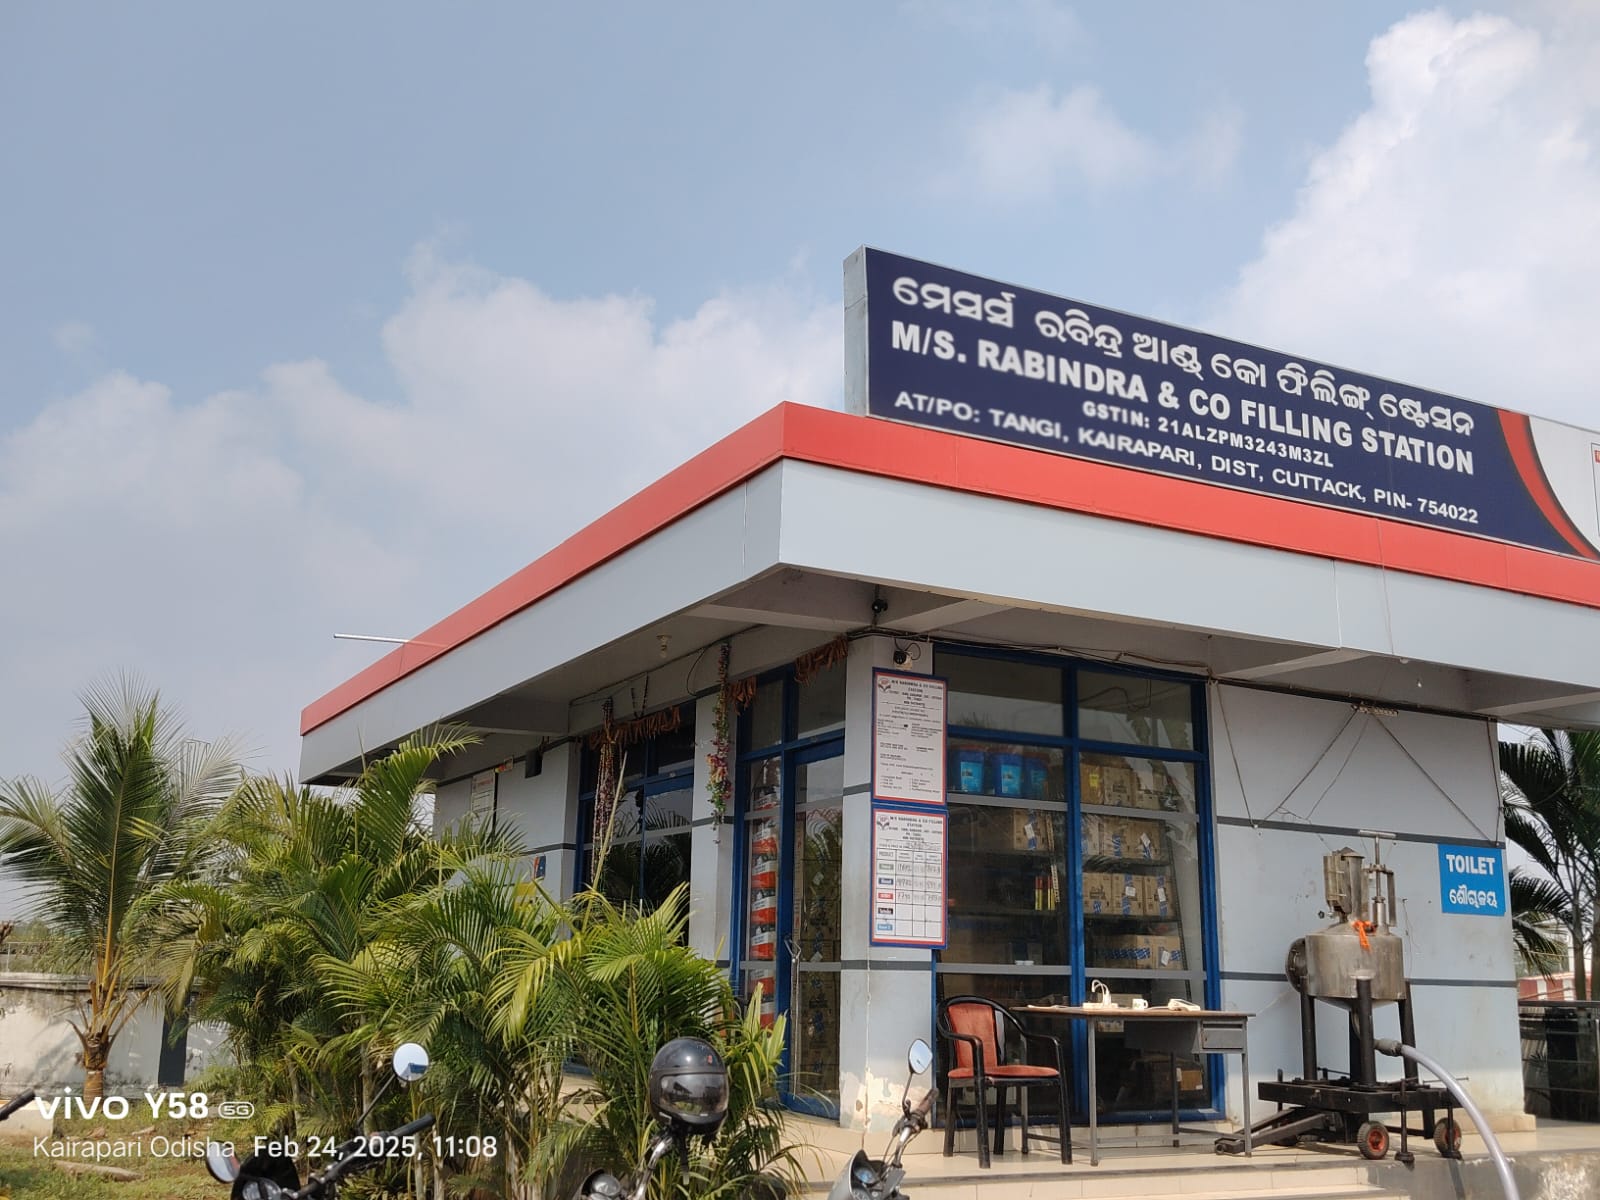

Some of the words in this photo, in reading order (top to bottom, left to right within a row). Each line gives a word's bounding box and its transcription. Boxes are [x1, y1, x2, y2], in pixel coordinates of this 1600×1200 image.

[892, 321, 967, 363] M/S.
[979, 339, 1149, 404] RABINDRA
[1158, 381, 1180, 410] &
[1190, 388, 1231, 421] CO
[1240, 399, 1353, 447] FILLING
[1361, 426, 1475, 476] STATION
[1034, 308, 1123, 359] ରବିନ୍ଦ୍ର
[1210, 353, 1267, 388] କୋ
[1379, 393, 1475, 436] ଷ୍ଟେସନ
[1082, 400, 1150, 429] GSTIN:
[1158, 416, 1334, 469] 21ALZPM3243M3ZL
[894, 391, 980, 423] AT/PO:
[988, 408, 1069, 443] TANGI,
[1078, 427, 1202, 471] KAIRAPARI,
[1211, 455, 1264, 483] DIST,
[1272, 468, 1367, 503] CUTTACK,
[1373, 488, 1413, 513] PIN-
[1417, 497, 1479, 524] 754022
[1445, 854, 1496, 875] TOILET
